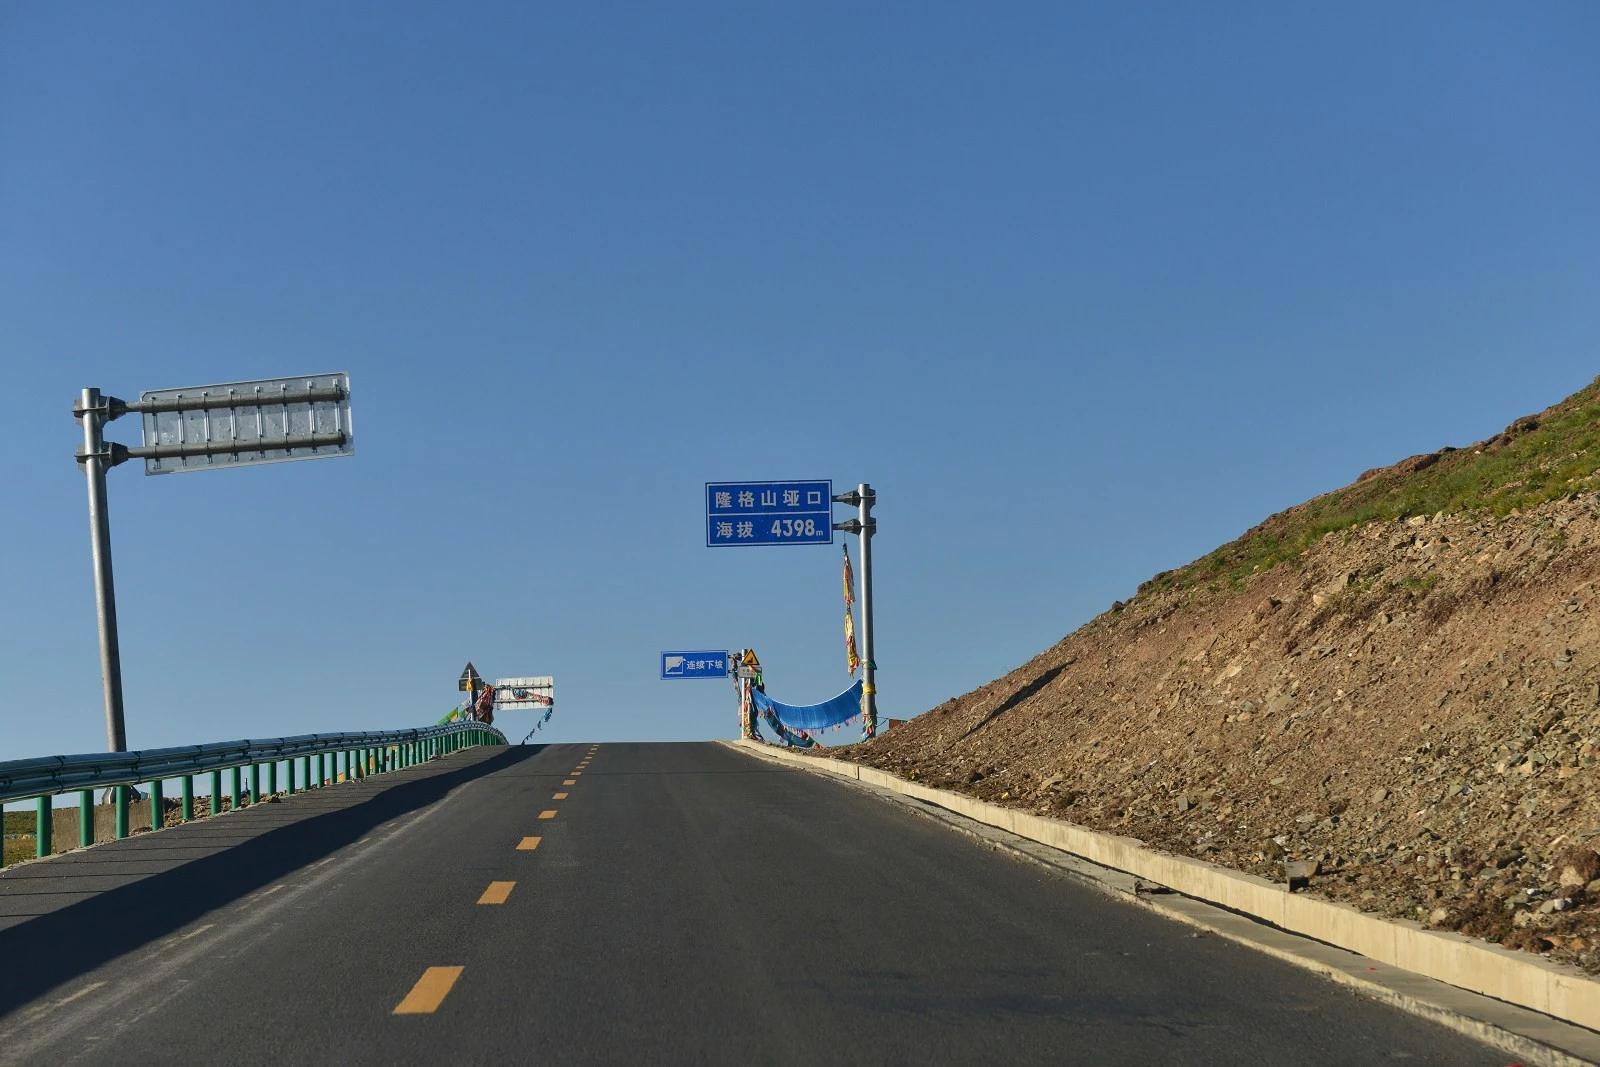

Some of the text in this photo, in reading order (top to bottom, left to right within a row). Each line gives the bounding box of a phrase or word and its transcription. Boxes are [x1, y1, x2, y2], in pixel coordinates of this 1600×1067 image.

[715, 490, 821, 508] 隆格山垭口
[716, 519, 824, 538] 海拔 4398m
